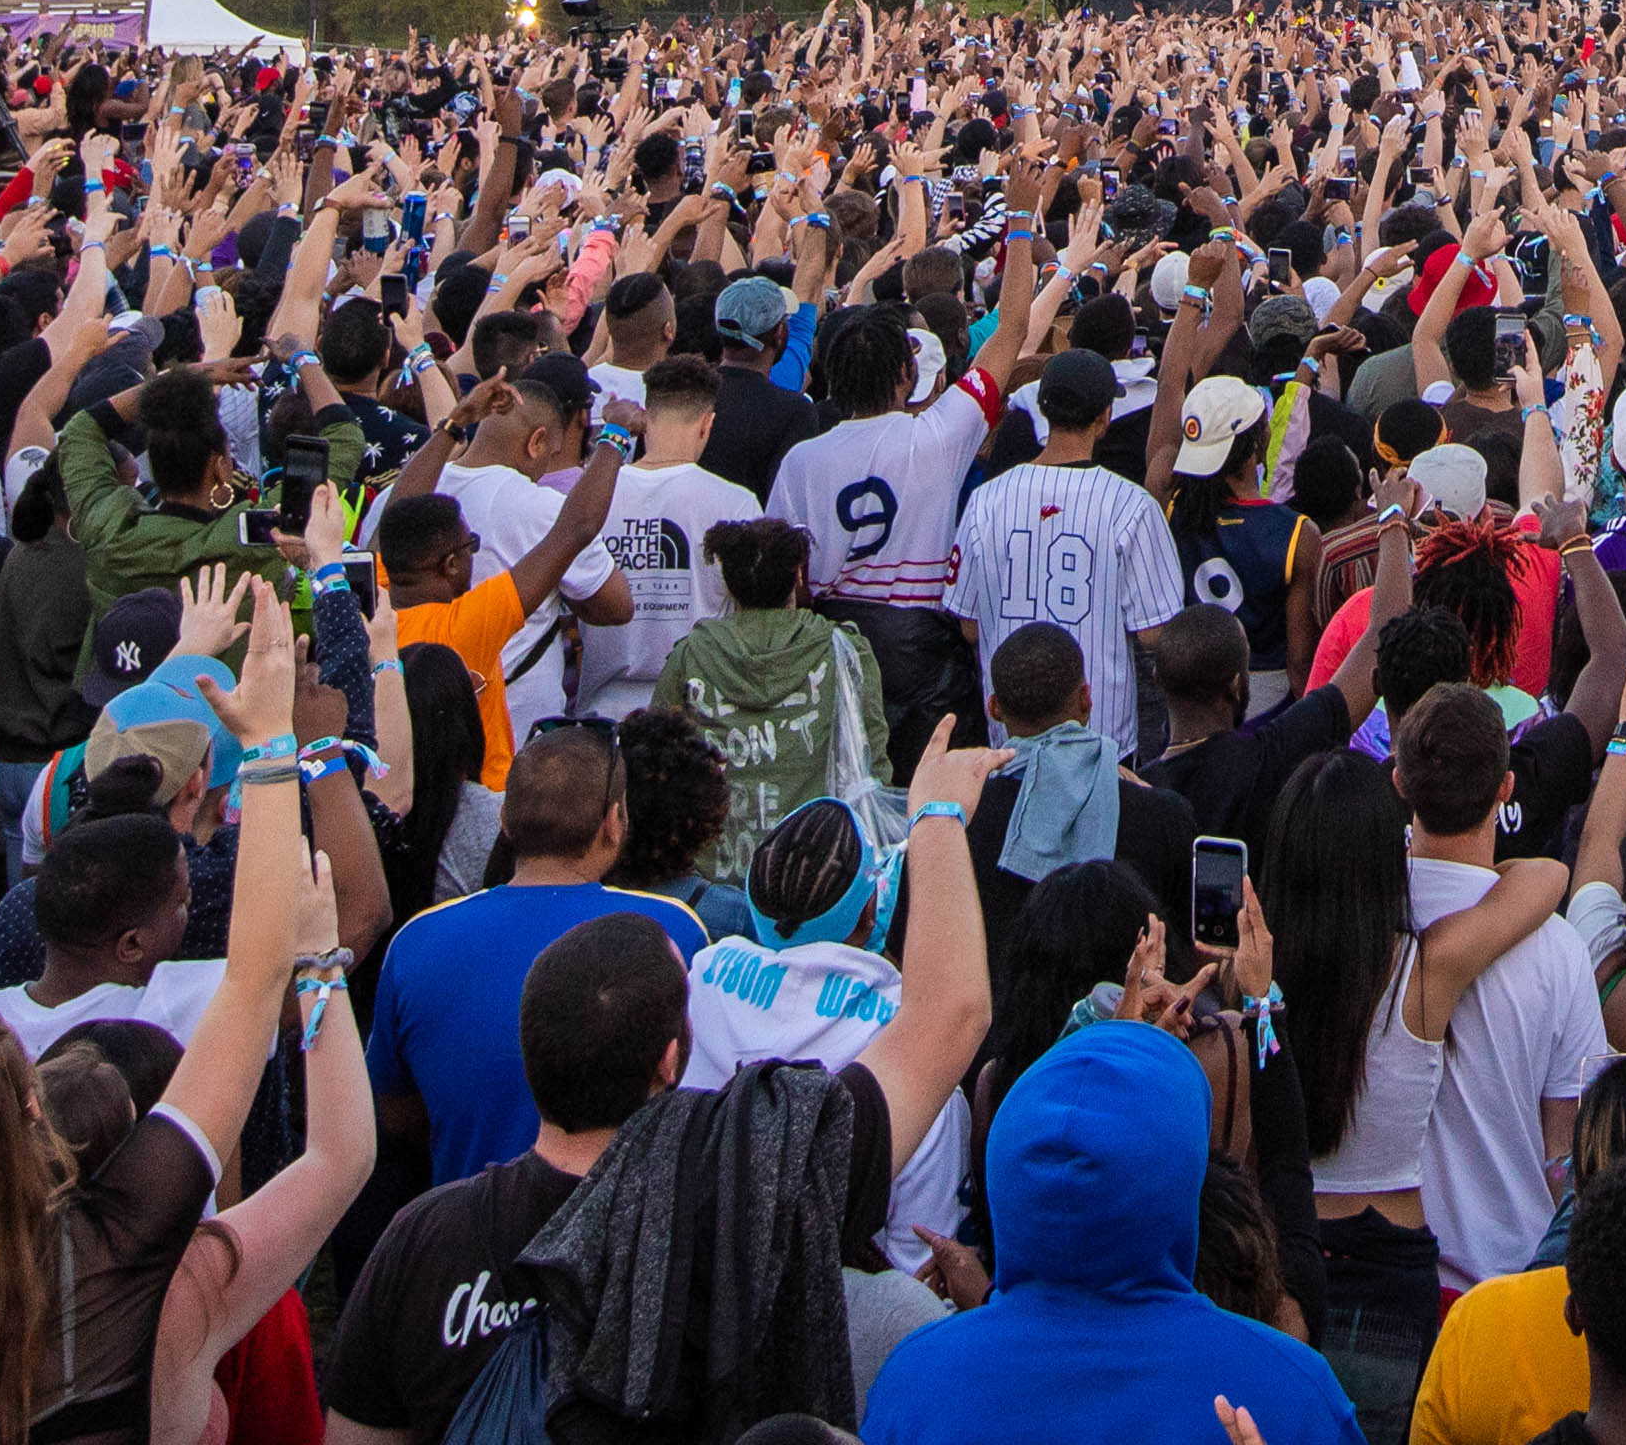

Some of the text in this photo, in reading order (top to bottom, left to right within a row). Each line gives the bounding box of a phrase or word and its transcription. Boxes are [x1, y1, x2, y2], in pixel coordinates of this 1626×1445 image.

[623, 518, 660, 535] THE
[836, 496, 898, 563] 9
[602, 535, 660, 553] ORTH
[611, 552, 660, 570] FACE
[1000, 529, 1094, 626] 18
